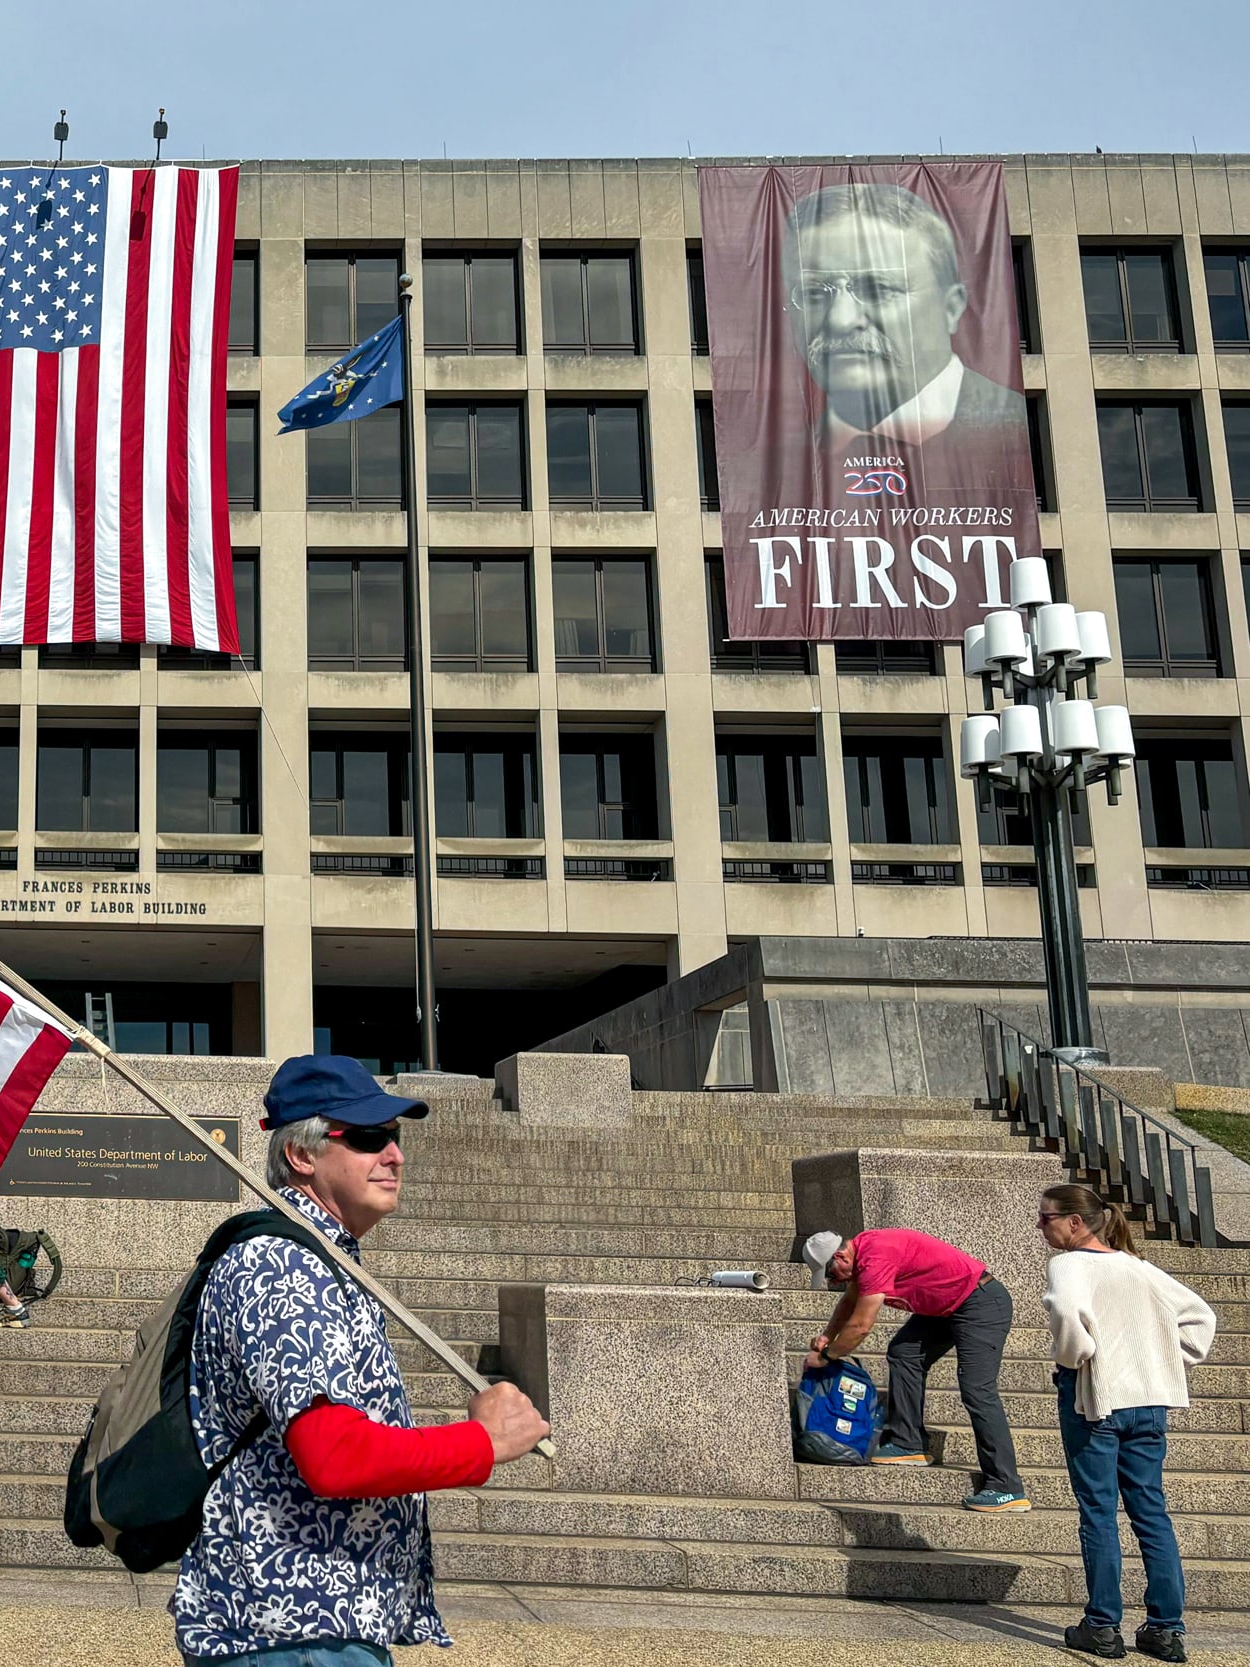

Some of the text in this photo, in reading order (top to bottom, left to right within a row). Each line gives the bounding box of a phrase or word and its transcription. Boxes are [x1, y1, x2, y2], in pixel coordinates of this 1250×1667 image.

[843, 456, 905, 467] AMERICA
[749, 506, 1013, 528] AMERICAN WORKERS
[749, 534, 1018, 610] FIRST
[22, 881, 151, 895] FRANCES PERKINS
[65, 901, 82, 913] OF
[91, 901, 135, 914] LABOR
[143, 903, 207, 916] BUILDING
[58, 1128, 84, 1137] Building
[28, 1147, 209, 1162] United States Department of Labor
